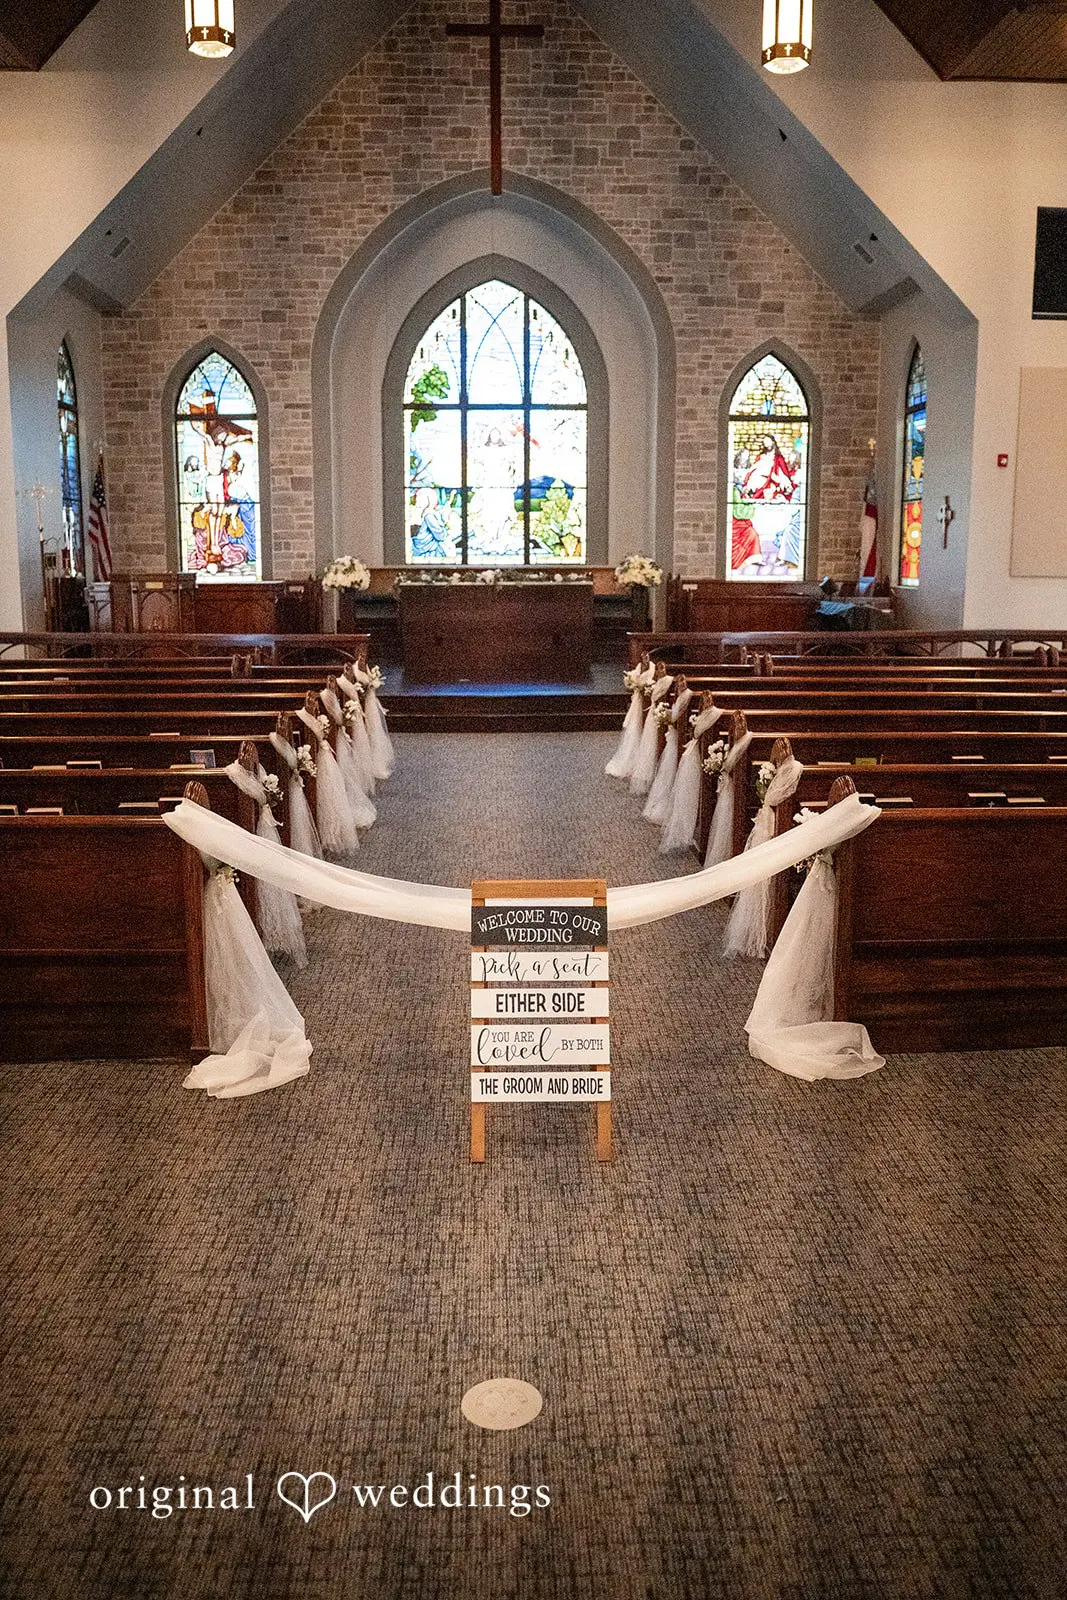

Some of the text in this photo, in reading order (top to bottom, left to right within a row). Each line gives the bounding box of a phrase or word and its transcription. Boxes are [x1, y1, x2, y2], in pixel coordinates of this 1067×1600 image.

[477, 909, 601, 936] WELCOME TO OUR
[504, 928, 573, 943] WEDDING
[495, 993, 585, 1013] EITHER SIDE
[477, 1027, 560, 1065] loved
[491, 1031, 535, 1043] YOU ARE
[561, 1039, 604, 1051] BY BOTH
[479, 1077, 604, 1095] THE GROOM AND BRIDE
